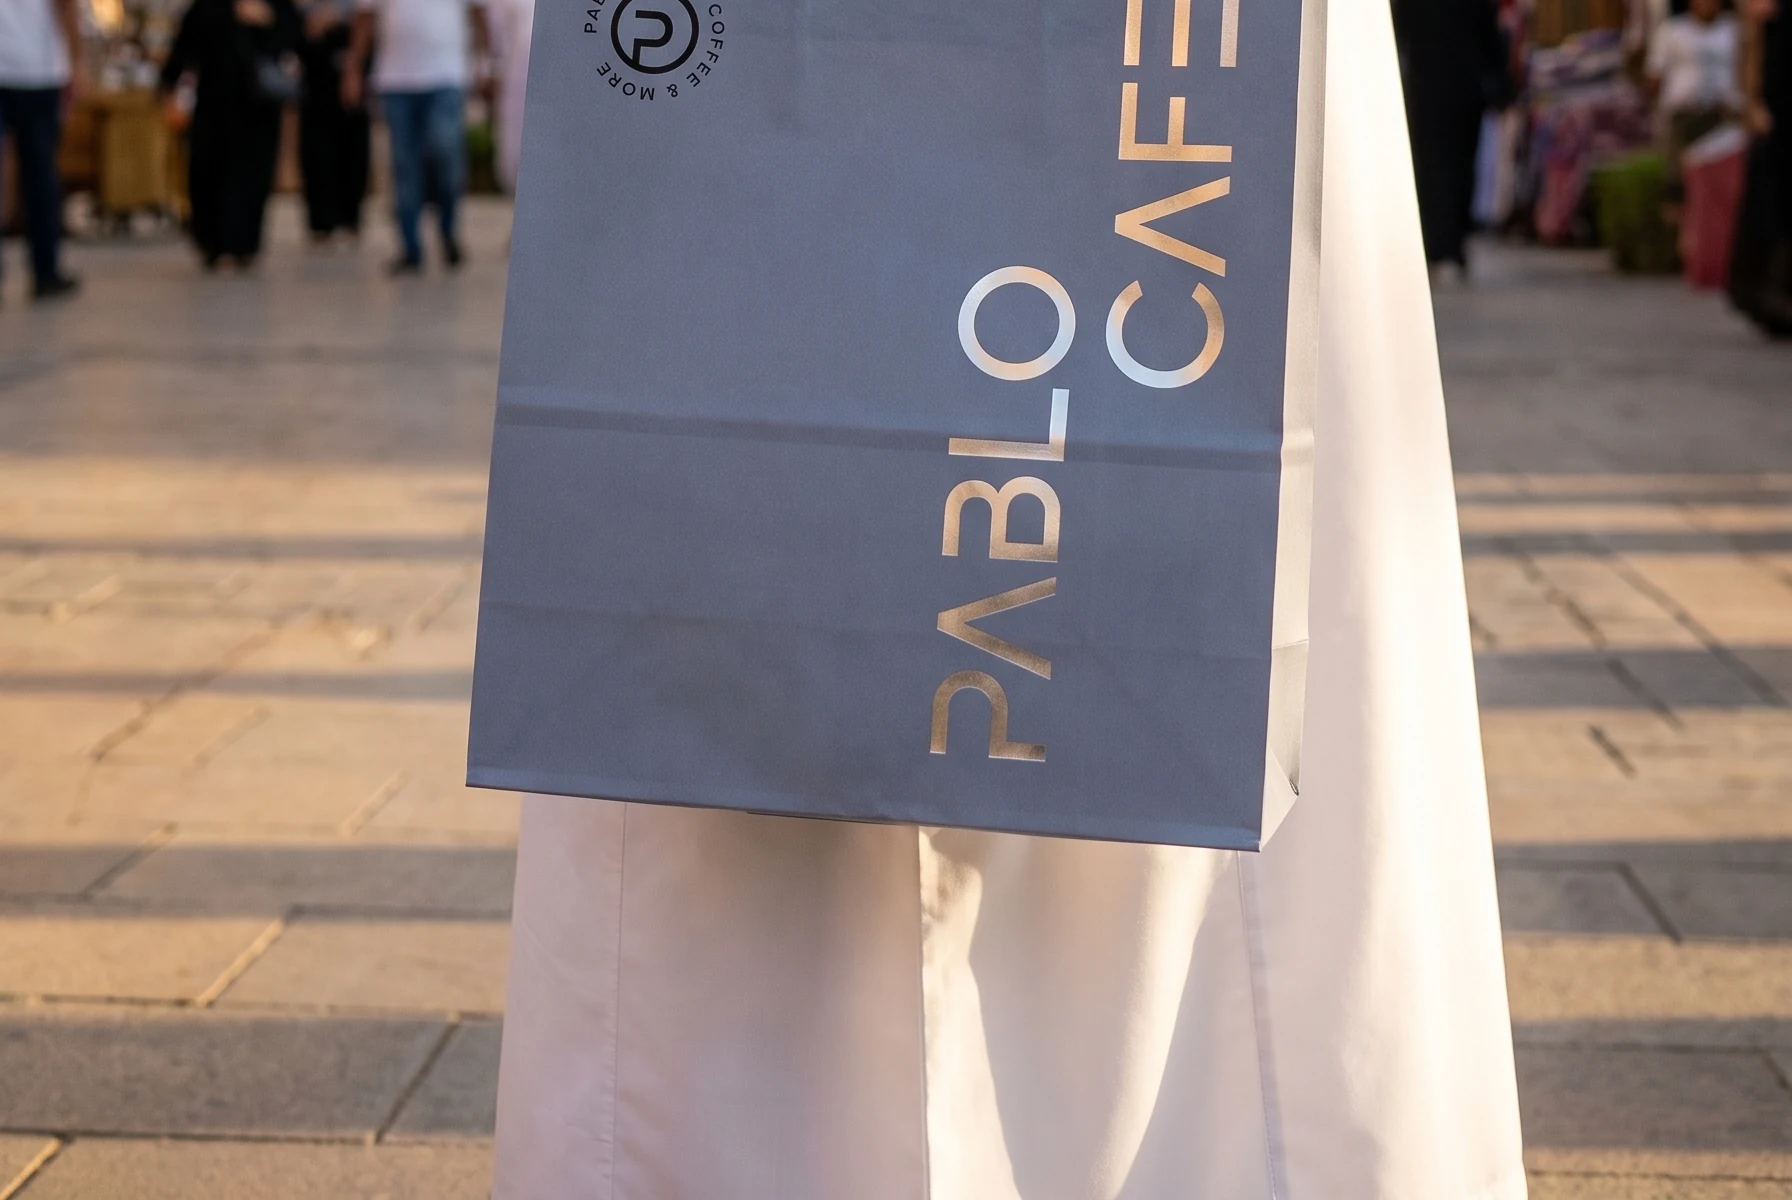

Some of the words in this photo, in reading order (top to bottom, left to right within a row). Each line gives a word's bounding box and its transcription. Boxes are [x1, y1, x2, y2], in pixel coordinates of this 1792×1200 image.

[686, 3, 725, 87] COFFEE
[596, 62, 655, 101] MORE
[666, 83, 679, 98] &
[930, 265, 1077, 763] PABLO
